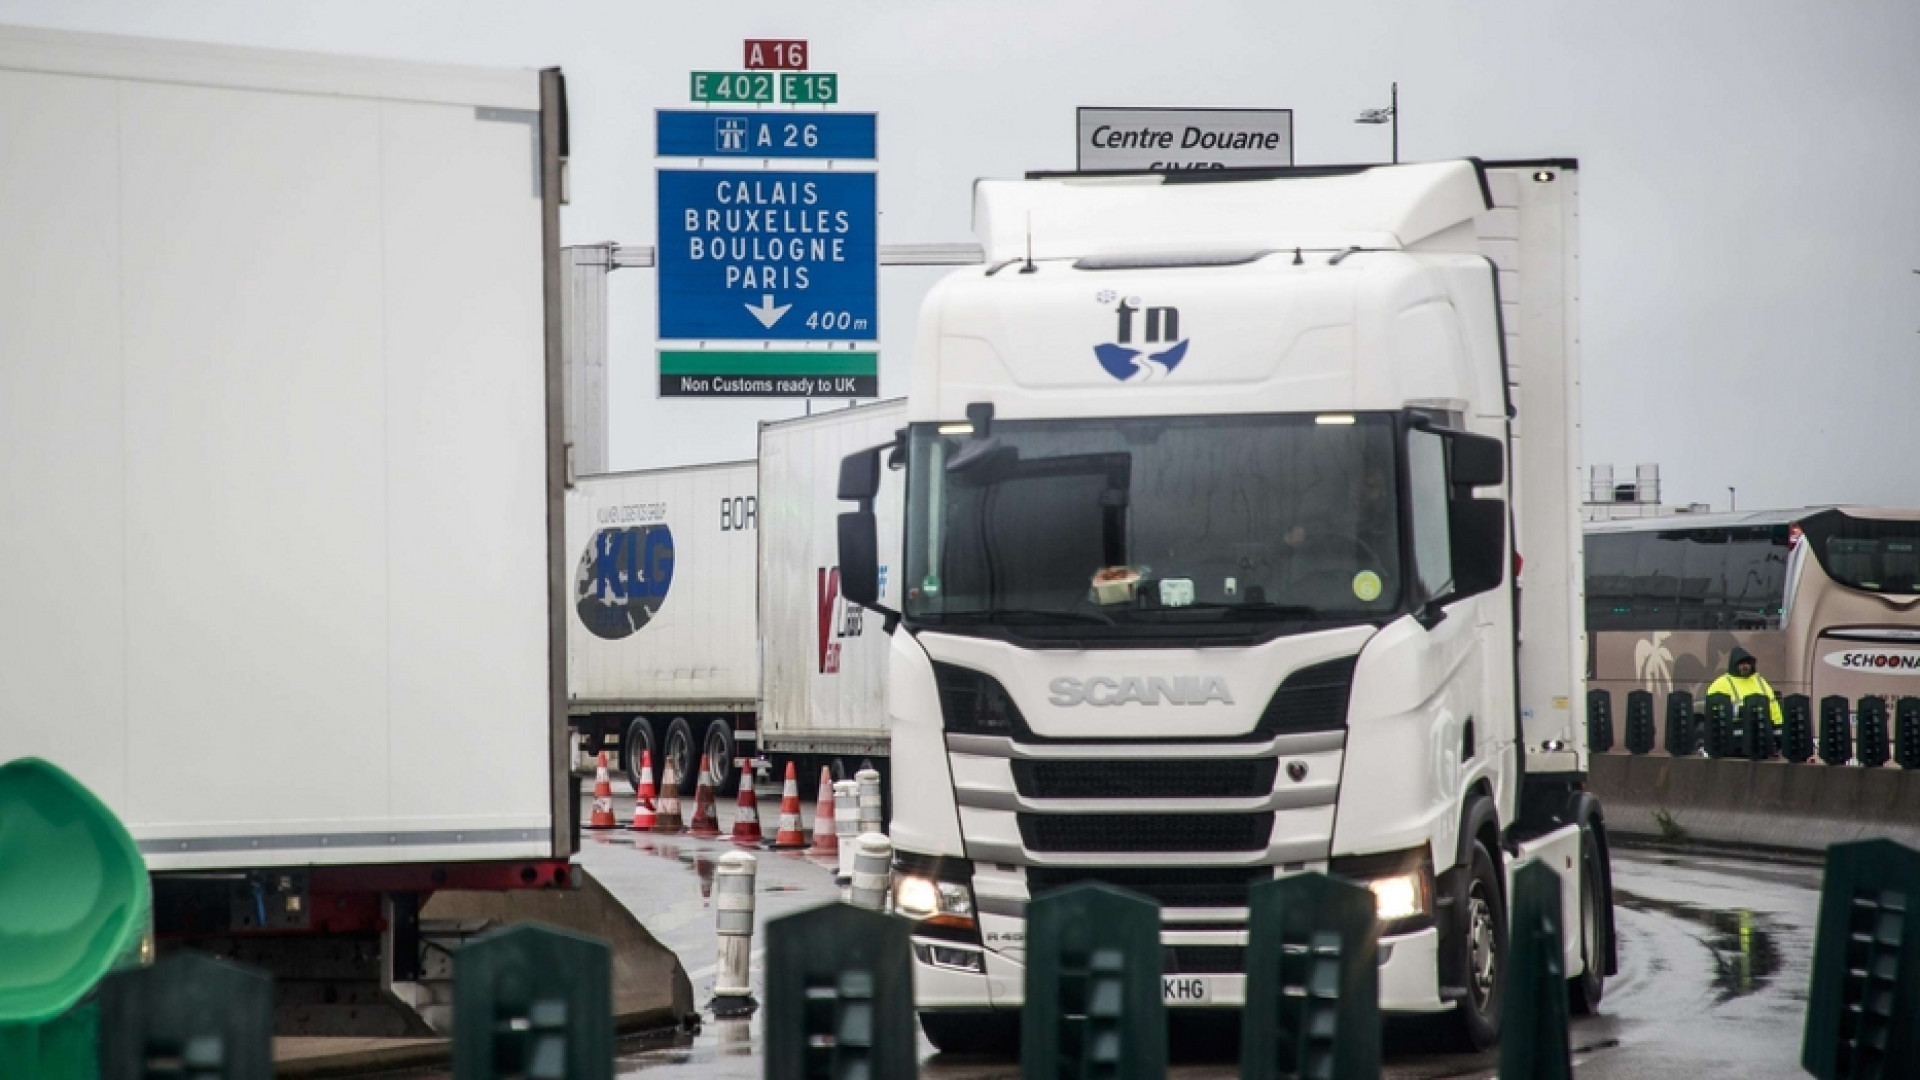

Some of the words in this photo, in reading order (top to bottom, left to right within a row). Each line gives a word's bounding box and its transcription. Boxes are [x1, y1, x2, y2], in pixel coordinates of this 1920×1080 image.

[749, 43, 764, 66] A
[773, 43, 803, 66] 16
[695, 75, 708, 98] E
[716, 75, 769, 99] 402
[785, 77, 797, 99] E
[804, 77, 832, 100] 15
[757, 123, 772, 147] A
[783, 124, 818, 147] 26
[1091, 125, 1174, 149] Centre
[1180, 127, 1280, 149] Douane
[716, 181, 818, 205] CALAIS
[684, 208, 849, 233] BRUXELLES
[690, 237, 845, 262] BOULOGNE
[725, 265, 810, 290] PARIS
[680, 376, 709, 392] Non
[712, 376, 774, 392] Customs
[776, 377, 815, 395] ready
[818, 378, 832, 392] to
[835, 378, 856, 392] UK
[596, 525, 674, 598] KLG
[1048, 675, 1237, 708] SCANIA
[1163, 978, 1205, 999] KHG
